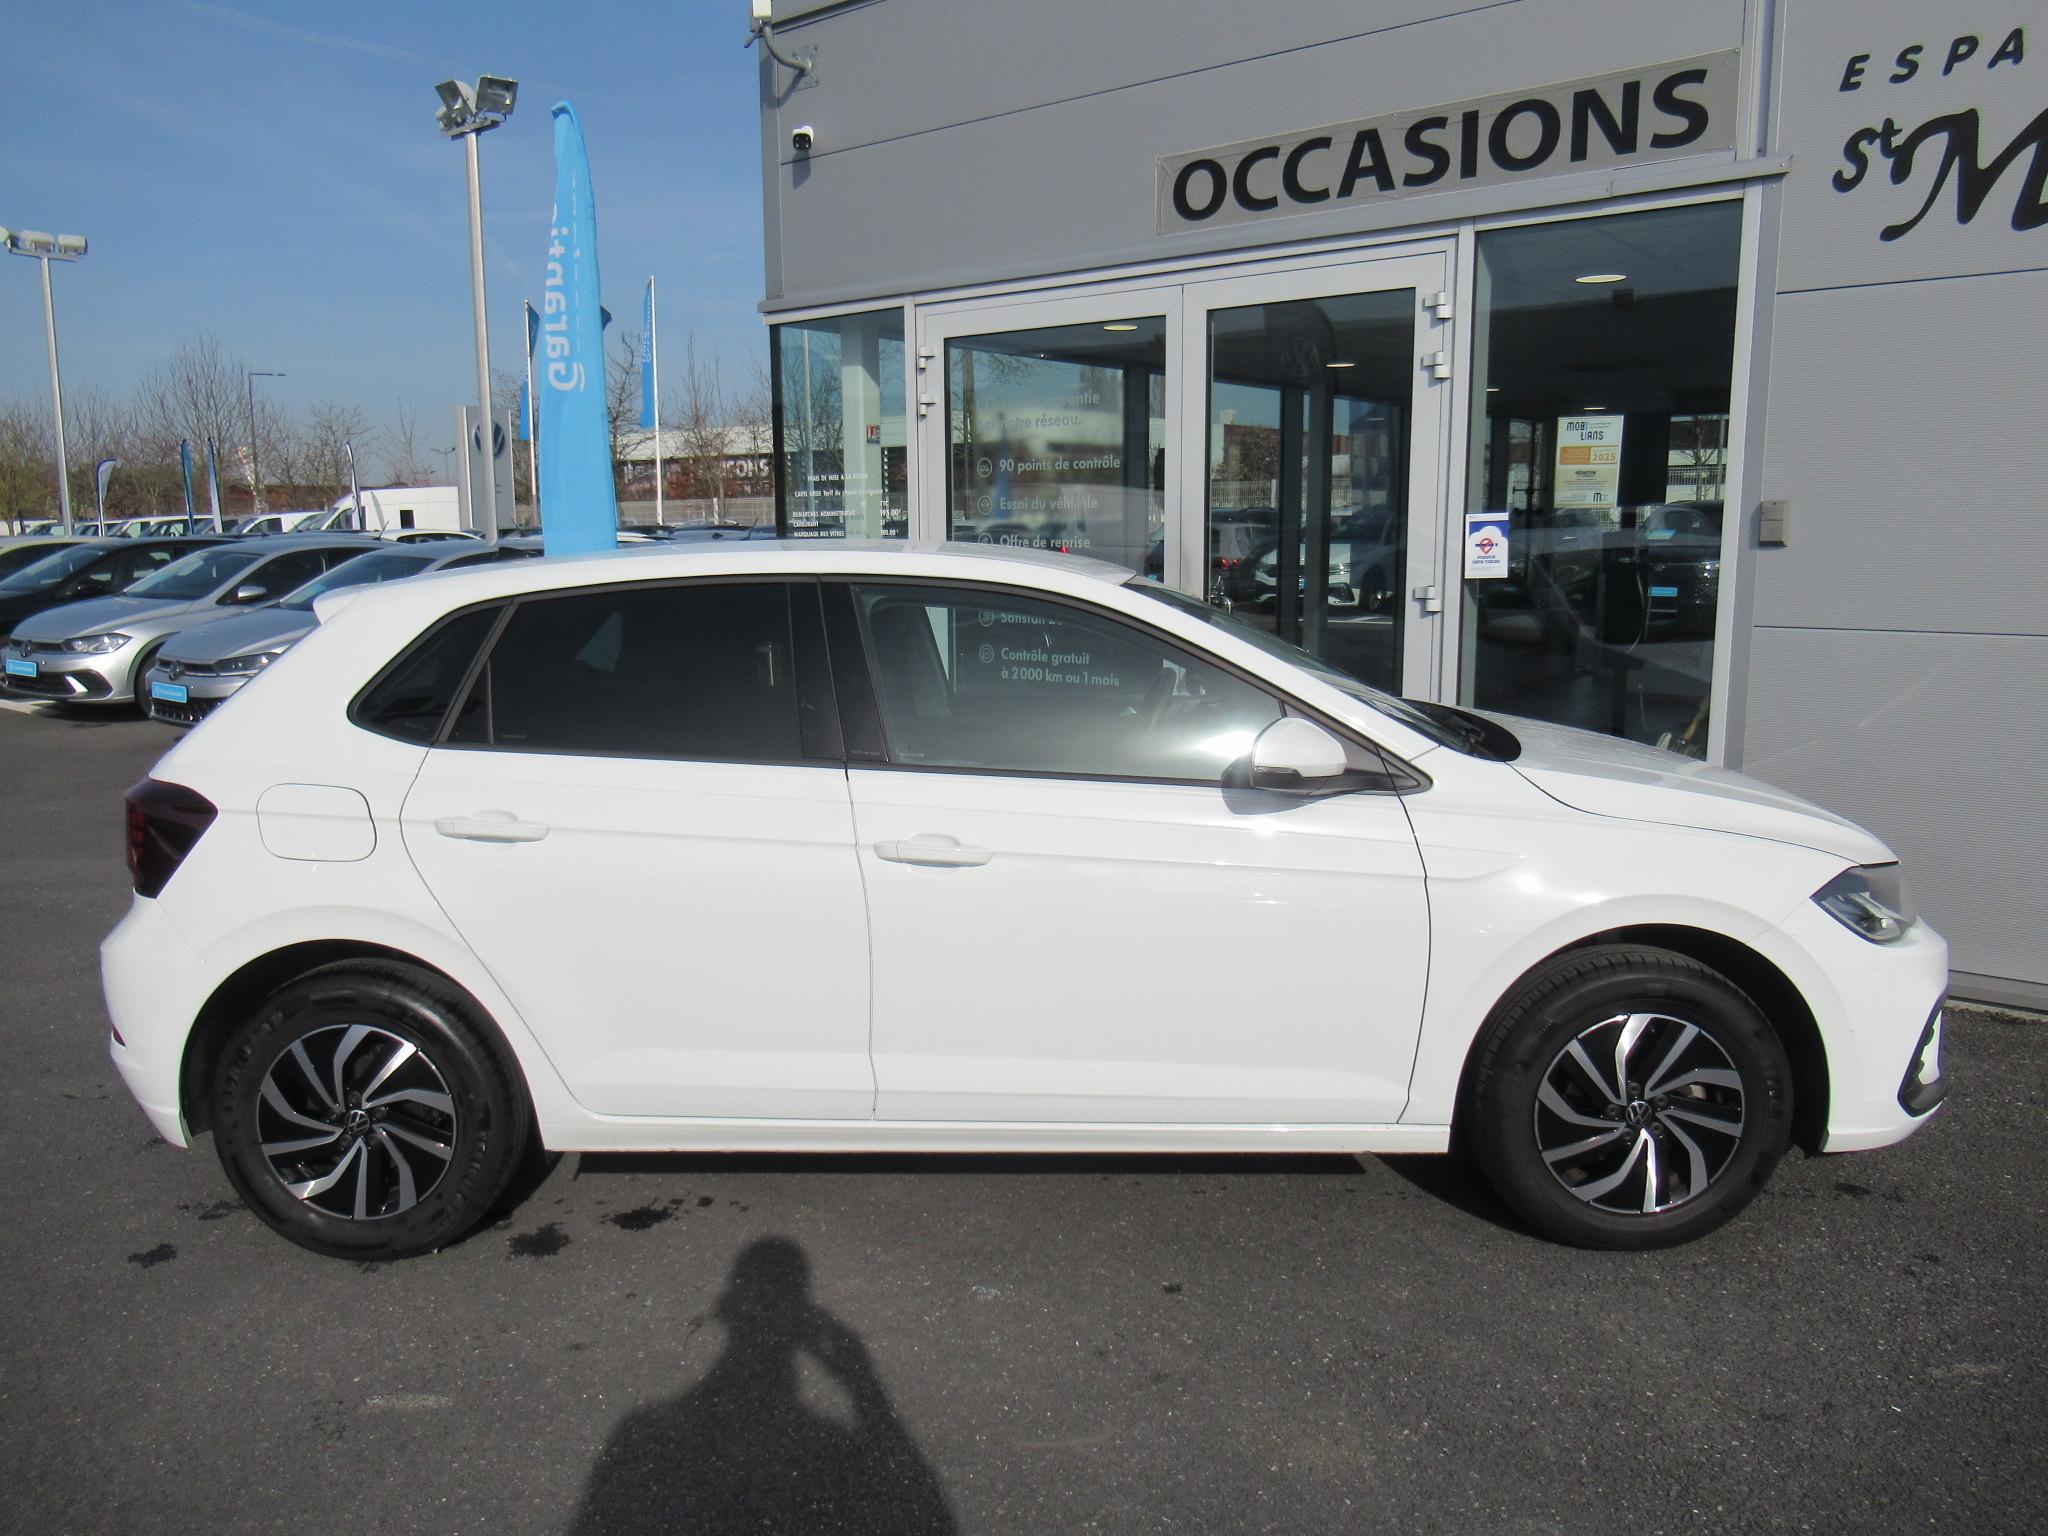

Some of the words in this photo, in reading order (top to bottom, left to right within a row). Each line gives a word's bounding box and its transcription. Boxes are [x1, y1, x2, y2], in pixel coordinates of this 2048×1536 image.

[1838, 27, 2024, 92] ESPA
[1171, 68, 1711, 222] OCCASIONS
[544, 202, 583, 393] Garanti
[999, 459, 1015, 472] 90
[1017, 458, 1052, 474] points
[1055, 457, 1069, 470] de
[1073, 455, 1121, 470] contrôle
[1592, 453, 1616, 462] 2025
[1000, 496, 1028, 510] Essai
[1031, 497, 1046, 509] du
[1000, 534, 1029, 548] Offre
[1032, 535, 1047, 548] de
[1001, 647, 1048, 662] Contrôle
[1051, 651, 1090, 665] gratuit
[1001, 667, 1009, 680] à
[1045, 668, 1062, 683] km
[1065, 674, 1080, 684] ou
[1091, 673, 1120, 687] mois
